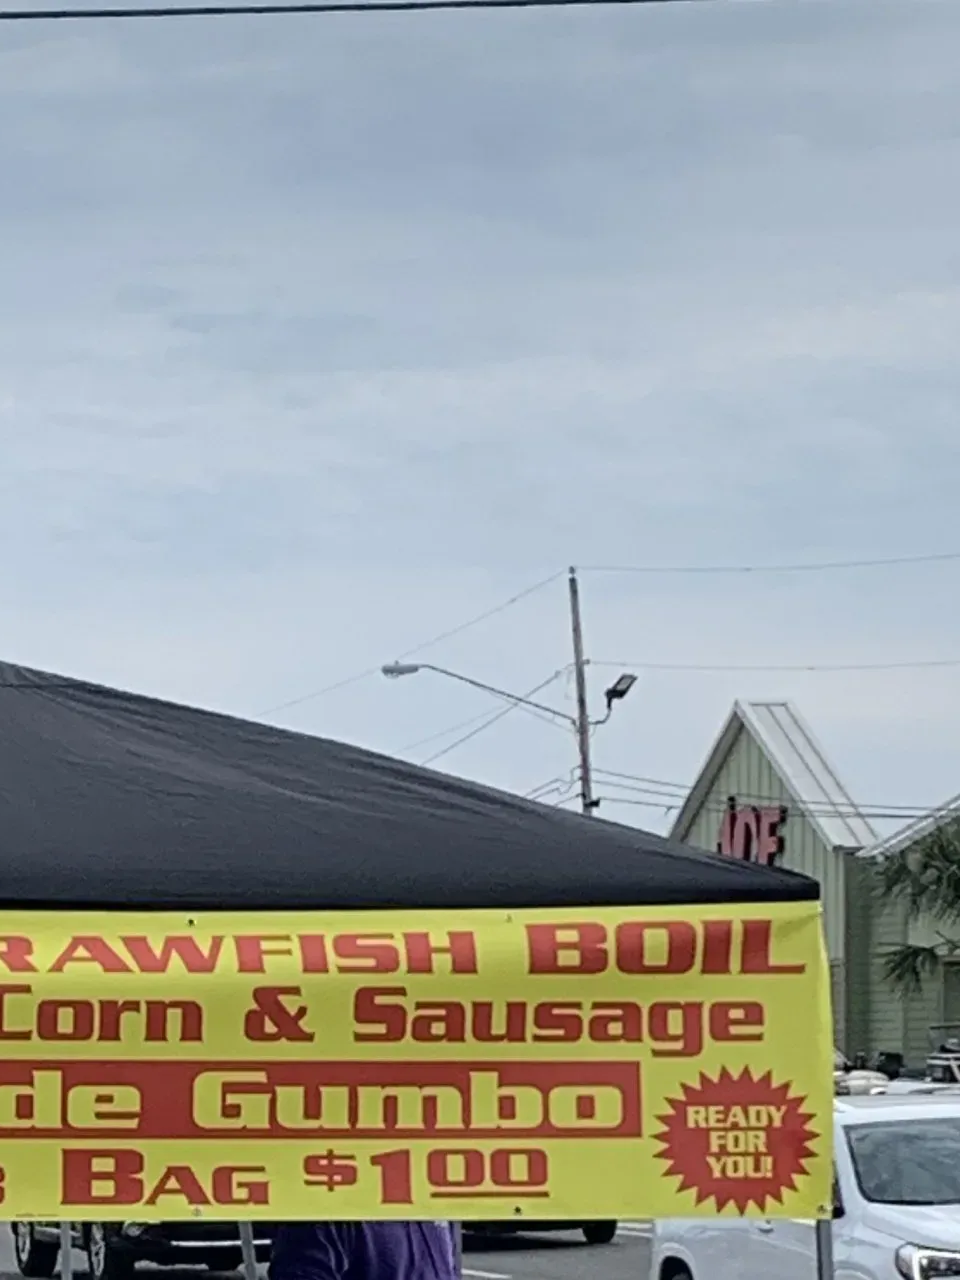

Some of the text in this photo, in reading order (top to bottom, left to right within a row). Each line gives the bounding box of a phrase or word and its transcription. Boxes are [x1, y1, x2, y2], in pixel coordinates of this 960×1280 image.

[525, 919, 807, 975] BOIL
[244, 985, 315, 1042] &
[353, 986, 765, 1057] Sausage
[192, 1069, 624, 1129] Gumbo
[686, 1105, 787, 1128] READY
[709, 1130, 768, 1153] FOR
[706, 1156, 774, 1179] YOU!
